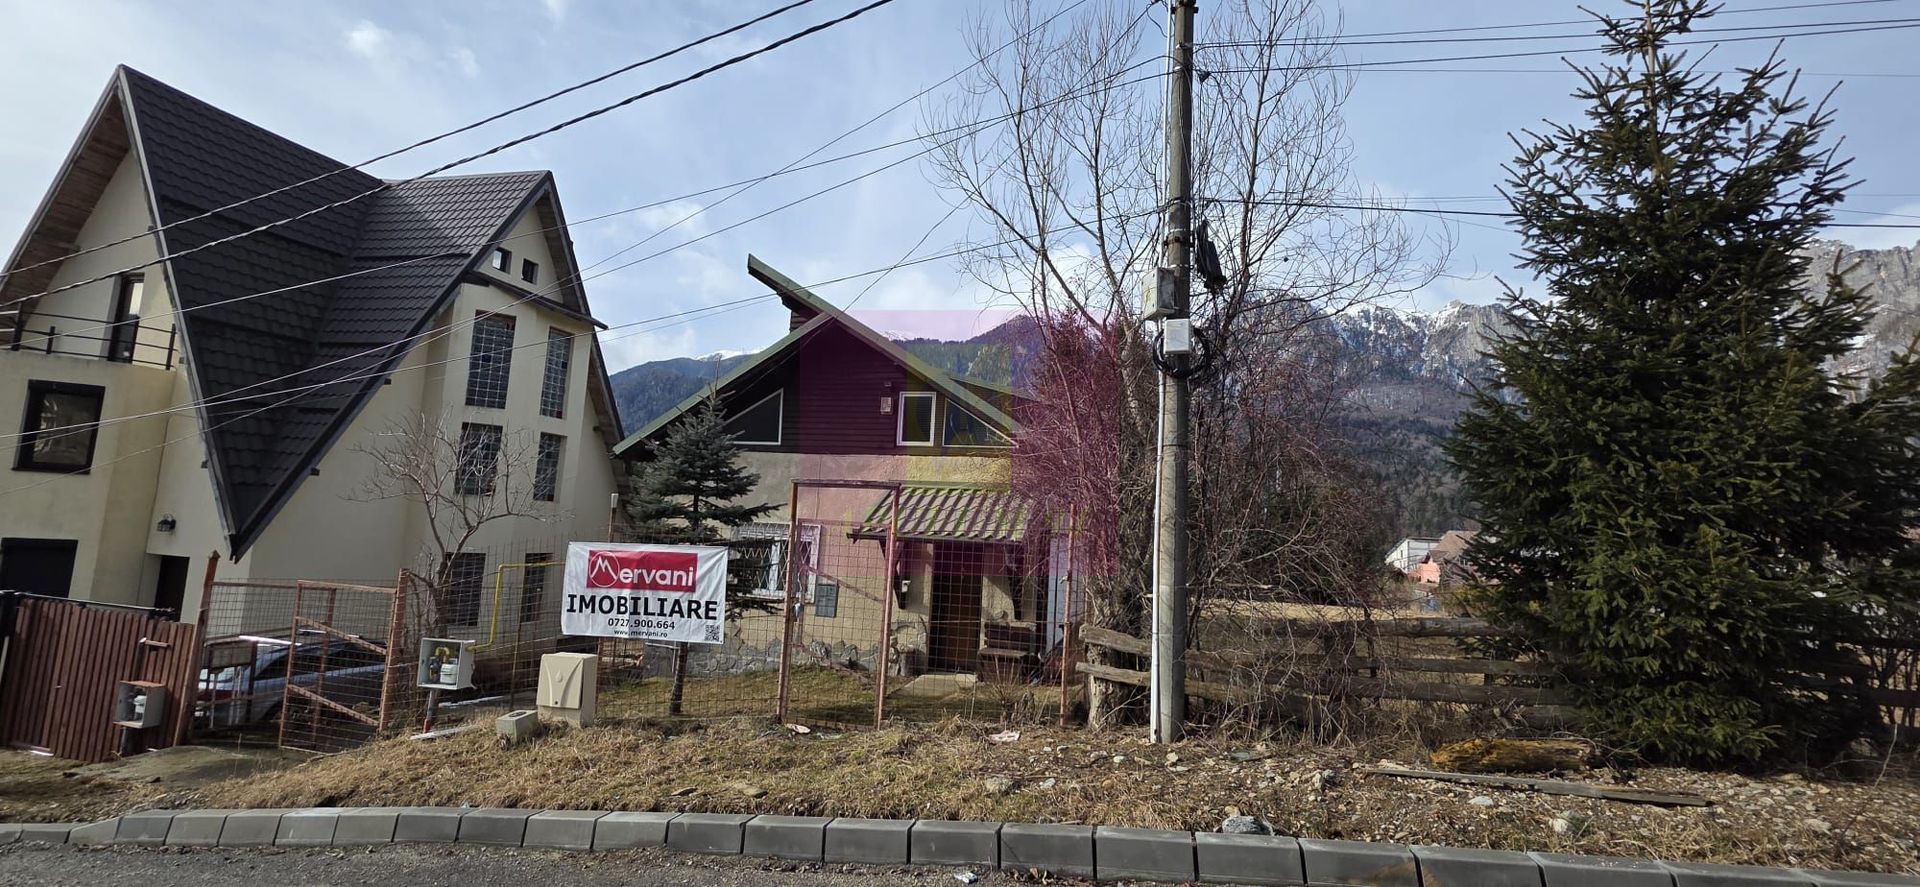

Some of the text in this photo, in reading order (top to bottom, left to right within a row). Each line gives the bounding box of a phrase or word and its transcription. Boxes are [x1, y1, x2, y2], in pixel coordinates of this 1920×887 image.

[589, 554, 694, 587] Mervani
[566, 593, 718, 621] IMOBILIARE
[607, 617, 675, 630] 0727.900.664
[613, 629, 668, 638] www.mervani.ro
